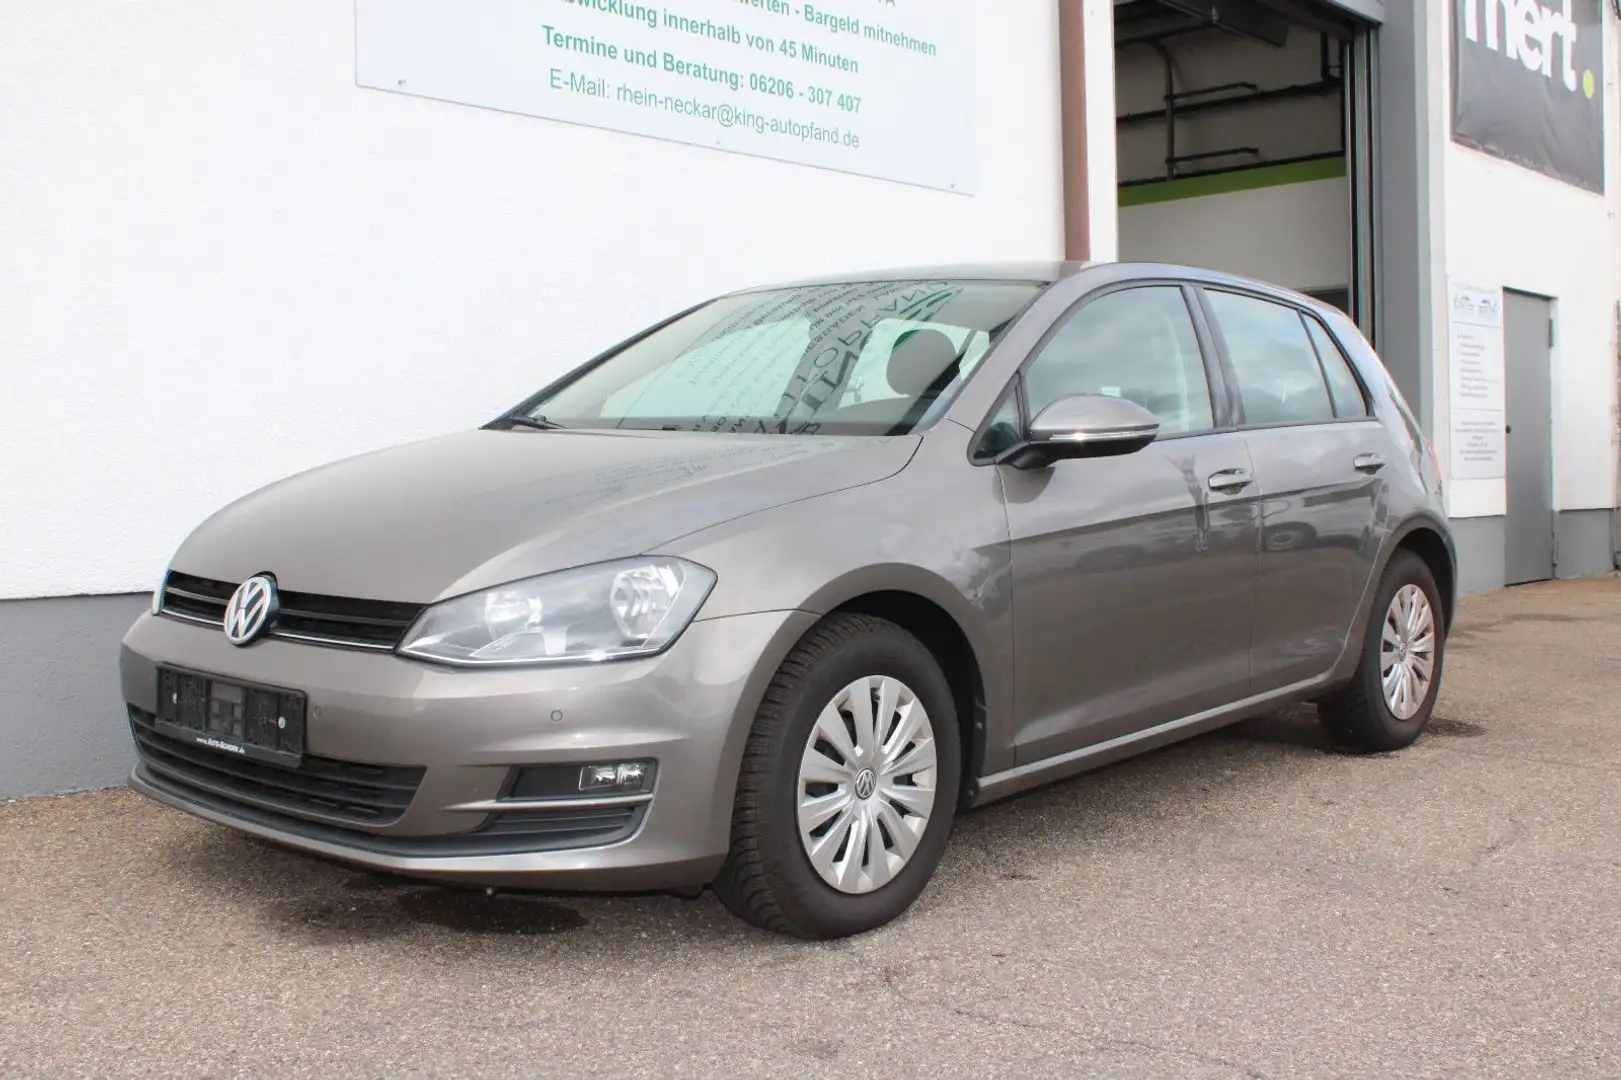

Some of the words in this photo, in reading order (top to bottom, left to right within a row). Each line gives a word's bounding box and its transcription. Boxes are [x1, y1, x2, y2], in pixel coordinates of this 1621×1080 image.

[663, 8, 741, 45] innerhalb
[746, 33, 774, 53] von
[779, 38, 797, 58] 45
[802, 43, 859, 73] Minuten
[804, 4, 860, 35] Bargeld
[863, 24, 937, 56] mitnehmen
[542, 25, 618, 59] Termine
[624, 48, 657, 68] und
[663, 52, 744, 91] Beratung:
[750, 72, 794, 99] 06206
[808, 86, 832, 107] 307
[837, 93, 861, 114] 407
[550, 68, 610, 99] E-Mail:
[616, 84, 860, 149] rhein-neckar@king-autopfand.de
